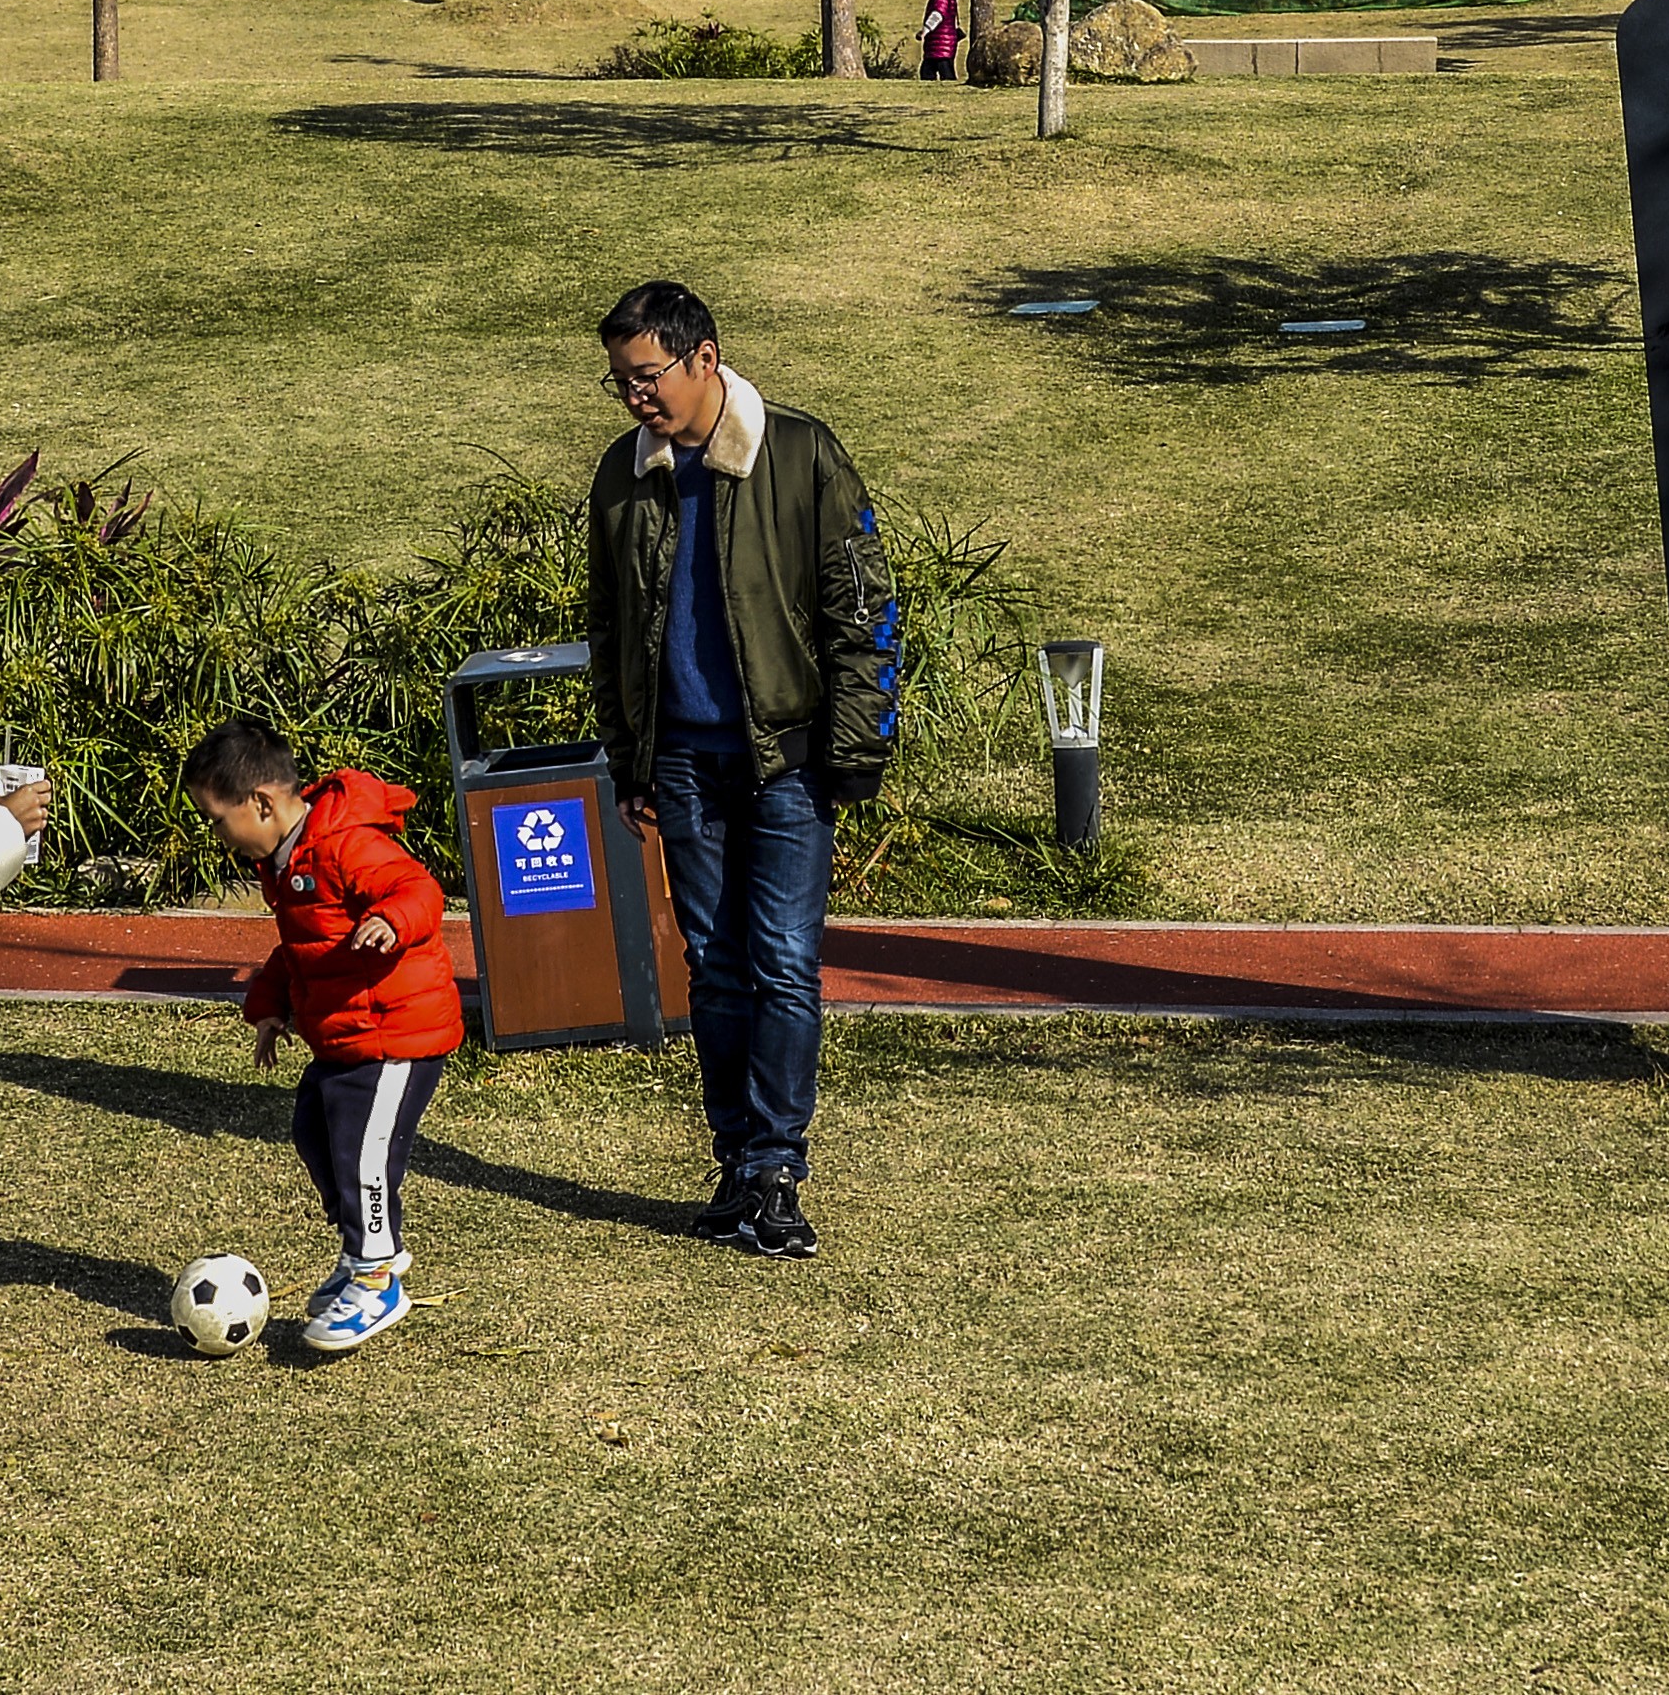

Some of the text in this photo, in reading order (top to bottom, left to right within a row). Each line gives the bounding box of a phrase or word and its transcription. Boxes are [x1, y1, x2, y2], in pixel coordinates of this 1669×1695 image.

[515, 853, 574, 871] 可回收物
[522, 871, 569, 883] RECYCLABLE
